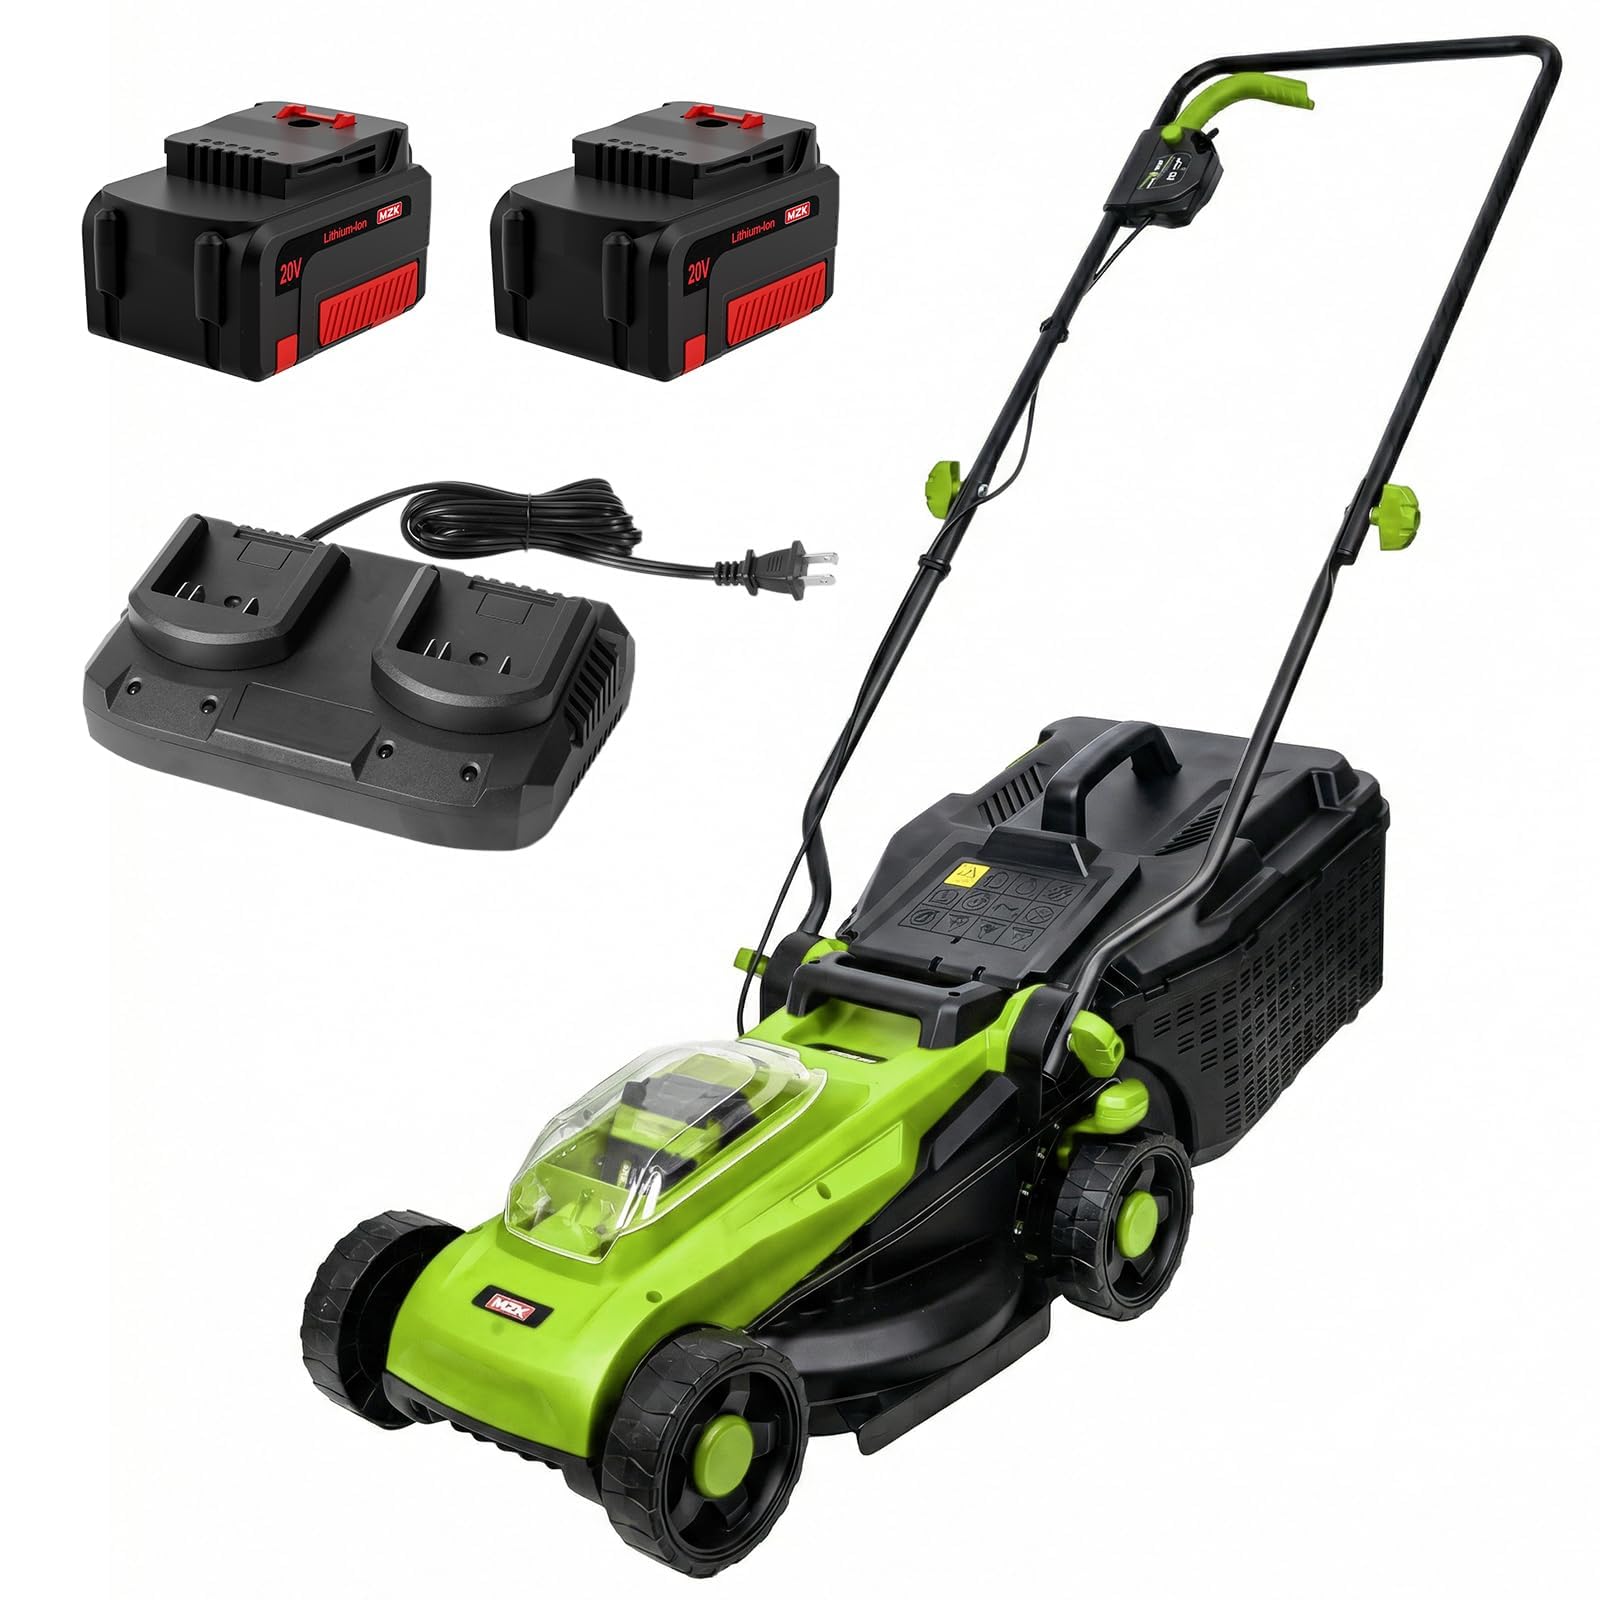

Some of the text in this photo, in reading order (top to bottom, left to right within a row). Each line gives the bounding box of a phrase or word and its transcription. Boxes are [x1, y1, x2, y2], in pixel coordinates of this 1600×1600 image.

[378, 204, 401, 222] MZK
[787, 204, 809, 222] MZK
[323, 219, 368, 244] Lithium-Ion
[731, 219, 776, 244] Lithium-Ion
[279, 257, 303, 285] 20V
[687, 257, 711, 285] 20V
